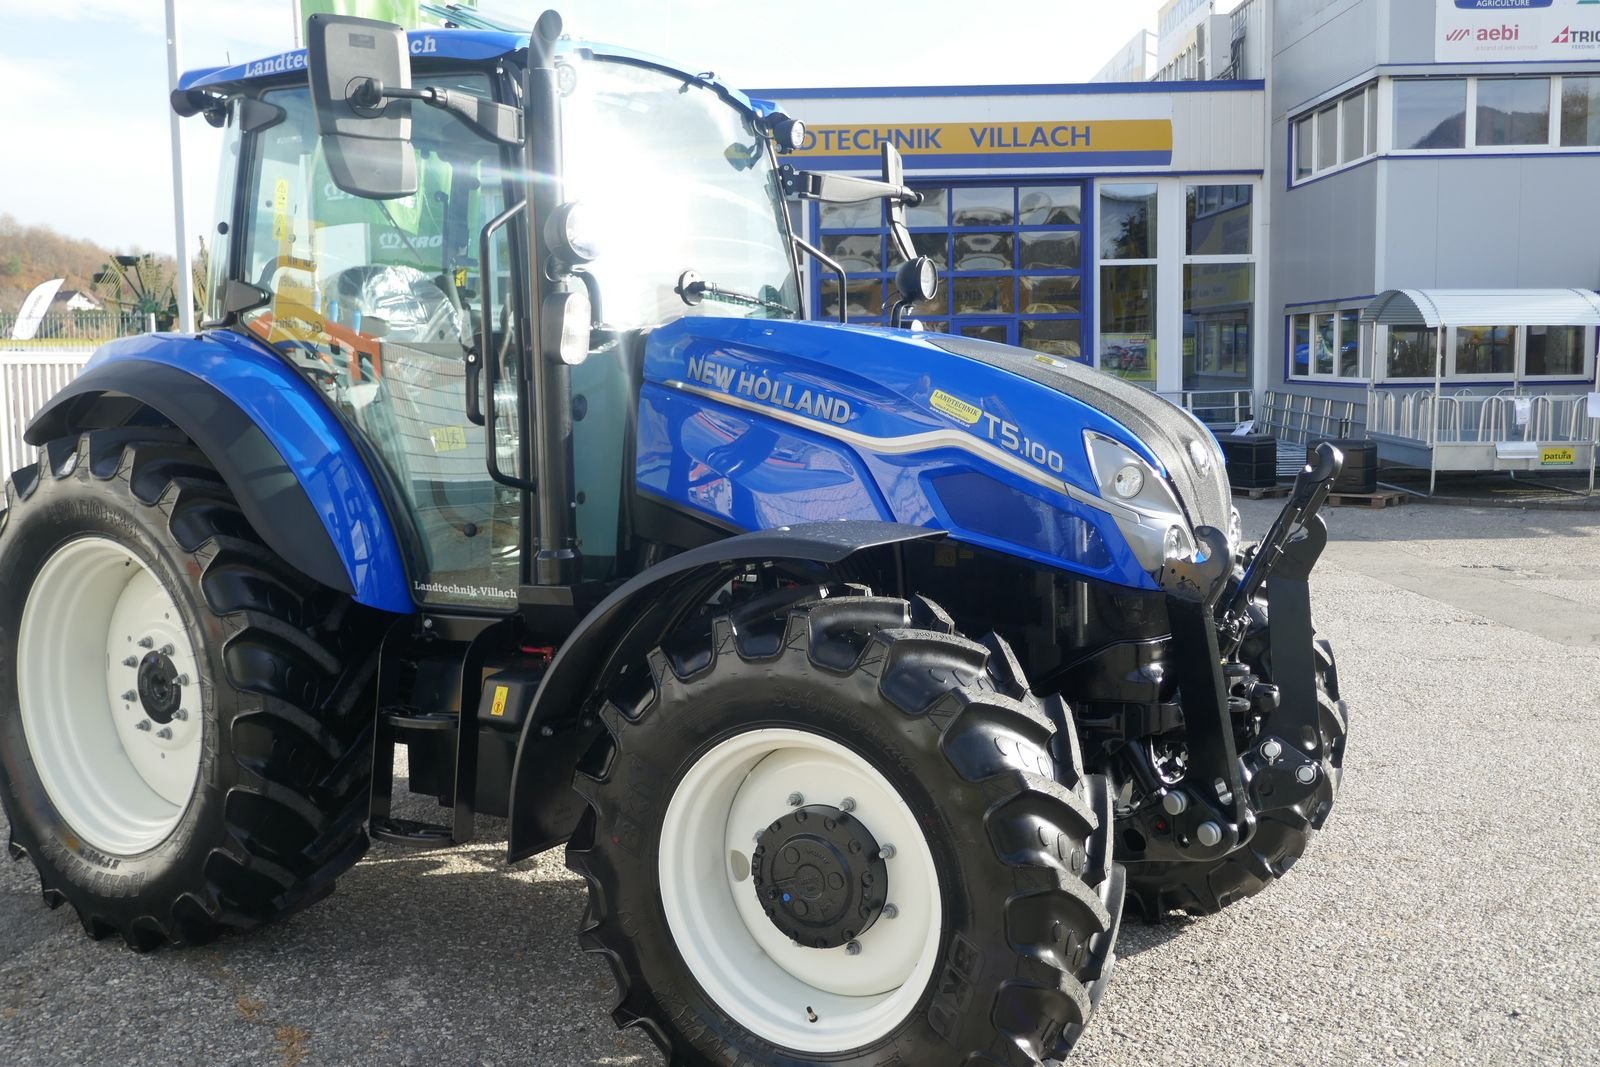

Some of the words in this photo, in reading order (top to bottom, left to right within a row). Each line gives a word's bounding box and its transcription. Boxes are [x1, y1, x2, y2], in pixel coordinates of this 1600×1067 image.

[1476, 24, 1520, 41] aebi
[410, 35, 437, 54] ch
[969, 125, 1091, 148] VILLACH
[686, 356, 736, 390] NEW
[736, 370, 851, 424] HOLLAND
[934, 391, 979, 417] LANDTECHNIK
[983, 411, 1063, 473] T5.100
[1544, 453, 1572, 461] patura
[414, 581, 518, 599] Landtechnik-Villach
